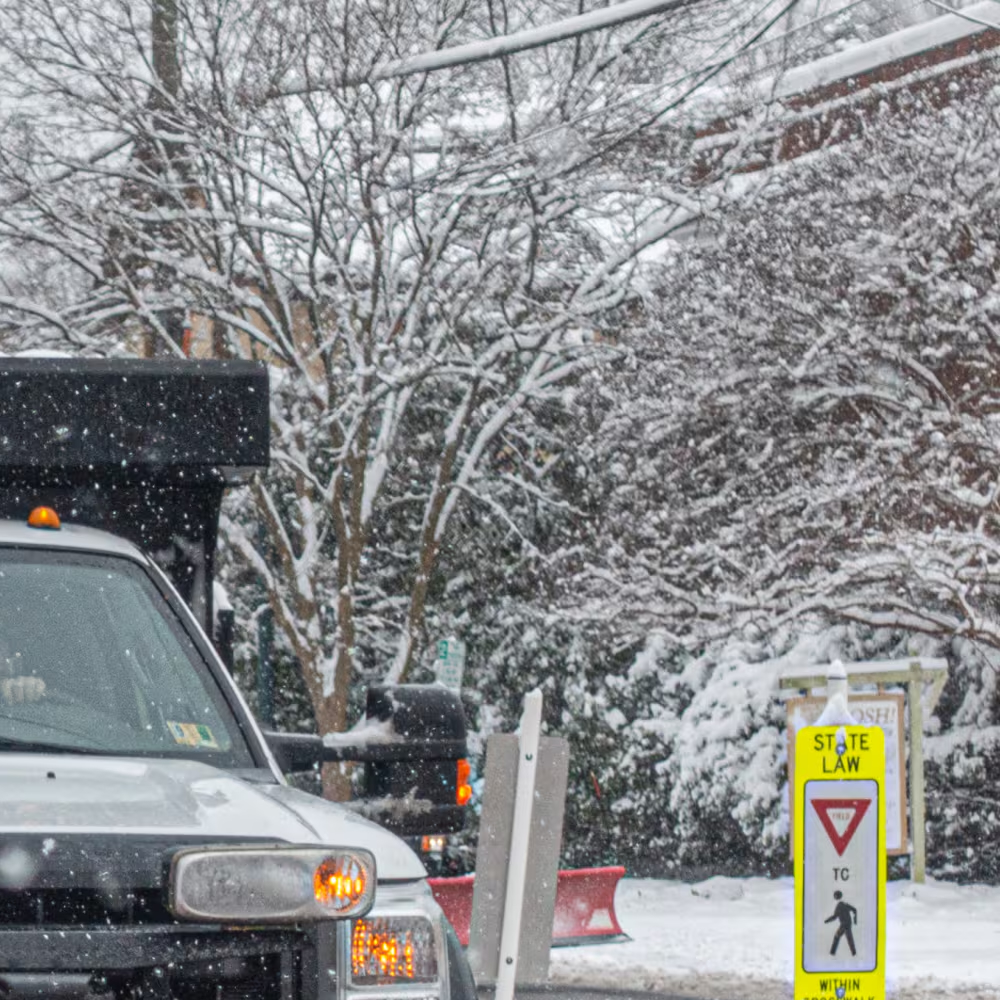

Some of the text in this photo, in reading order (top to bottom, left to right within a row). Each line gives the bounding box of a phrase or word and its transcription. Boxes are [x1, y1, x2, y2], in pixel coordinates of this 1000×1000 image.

[851, 707, 896, 725] OSH!
[822, 756, 860, 773] LAW
[819, 978, 860, 992] WITHIN
